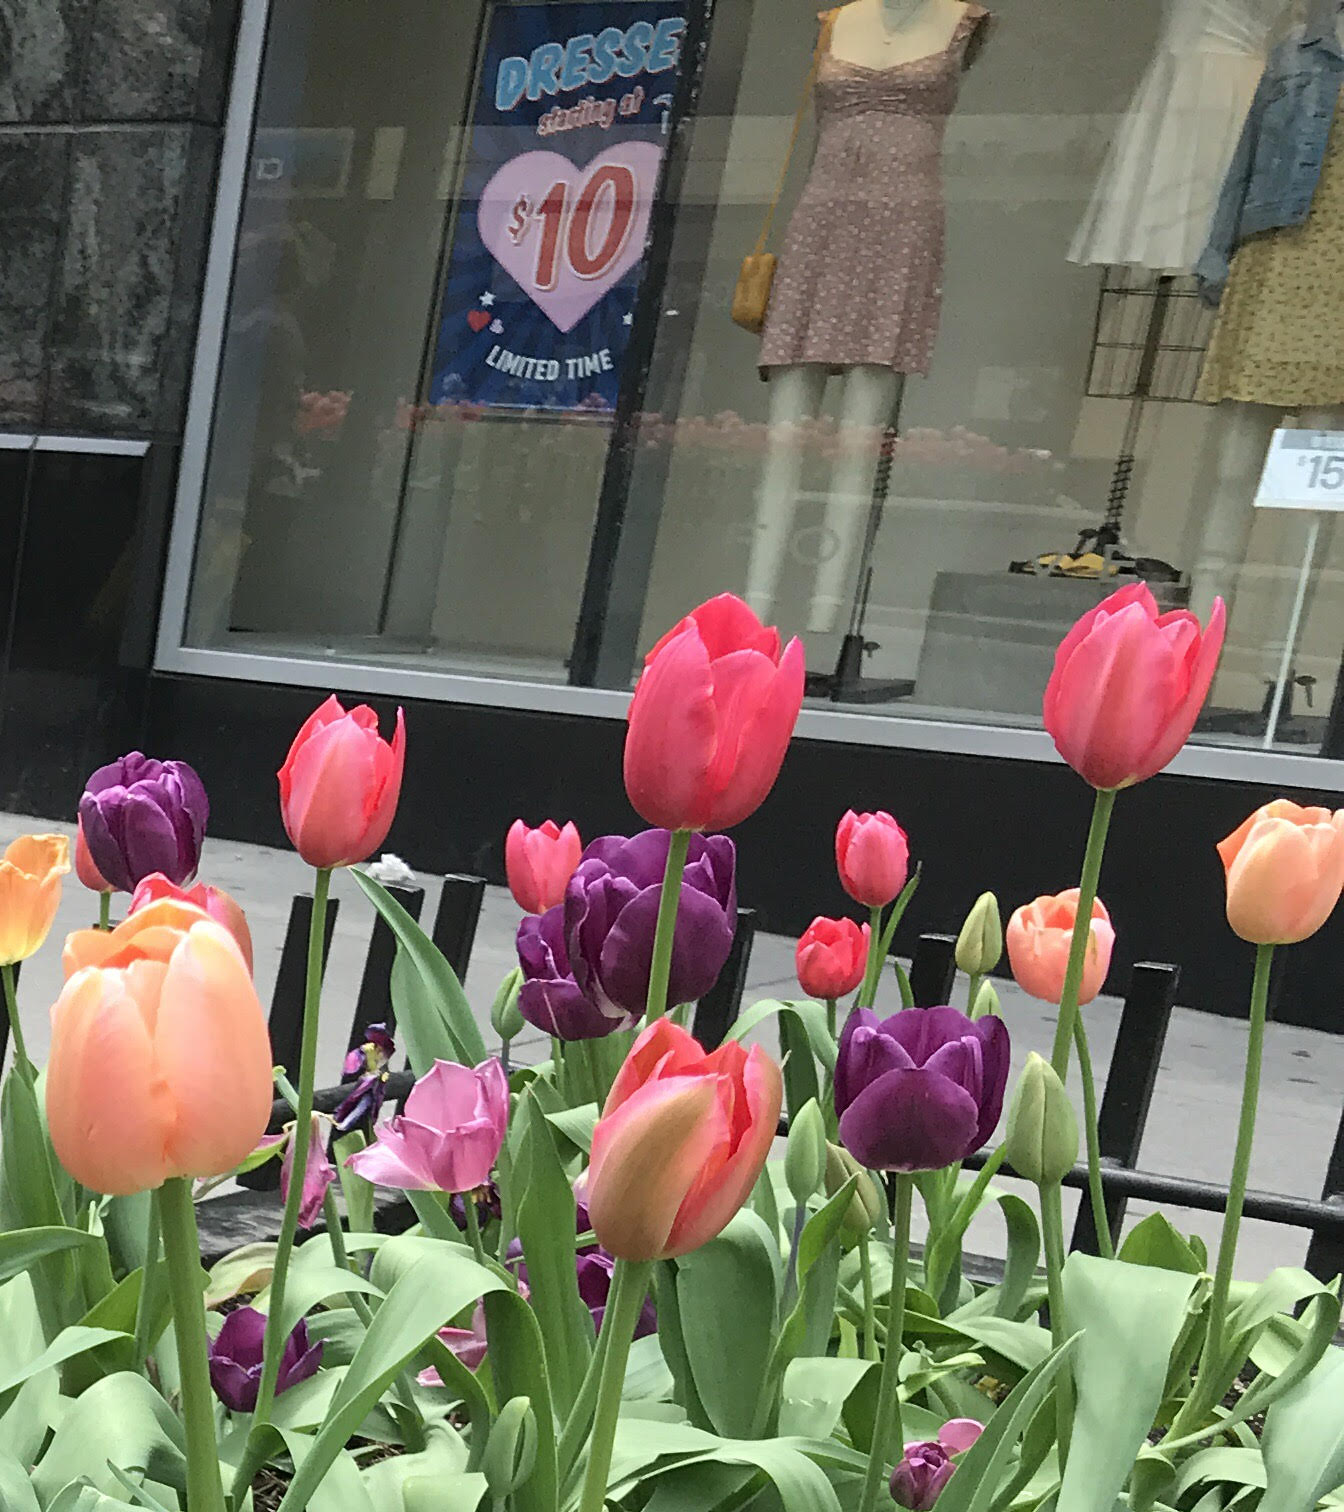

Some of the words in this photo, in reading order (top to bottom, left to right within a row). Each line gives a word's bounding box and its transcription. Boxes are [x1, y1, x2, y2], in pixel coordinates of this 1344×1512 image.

[536, 96, 617, 136] starting
[619, 86, 645, 118] at
[508, 163, 638, 291] $10
[485, 345, 560, 381] LIMITED
[565, 348, 614, 379] TIME
